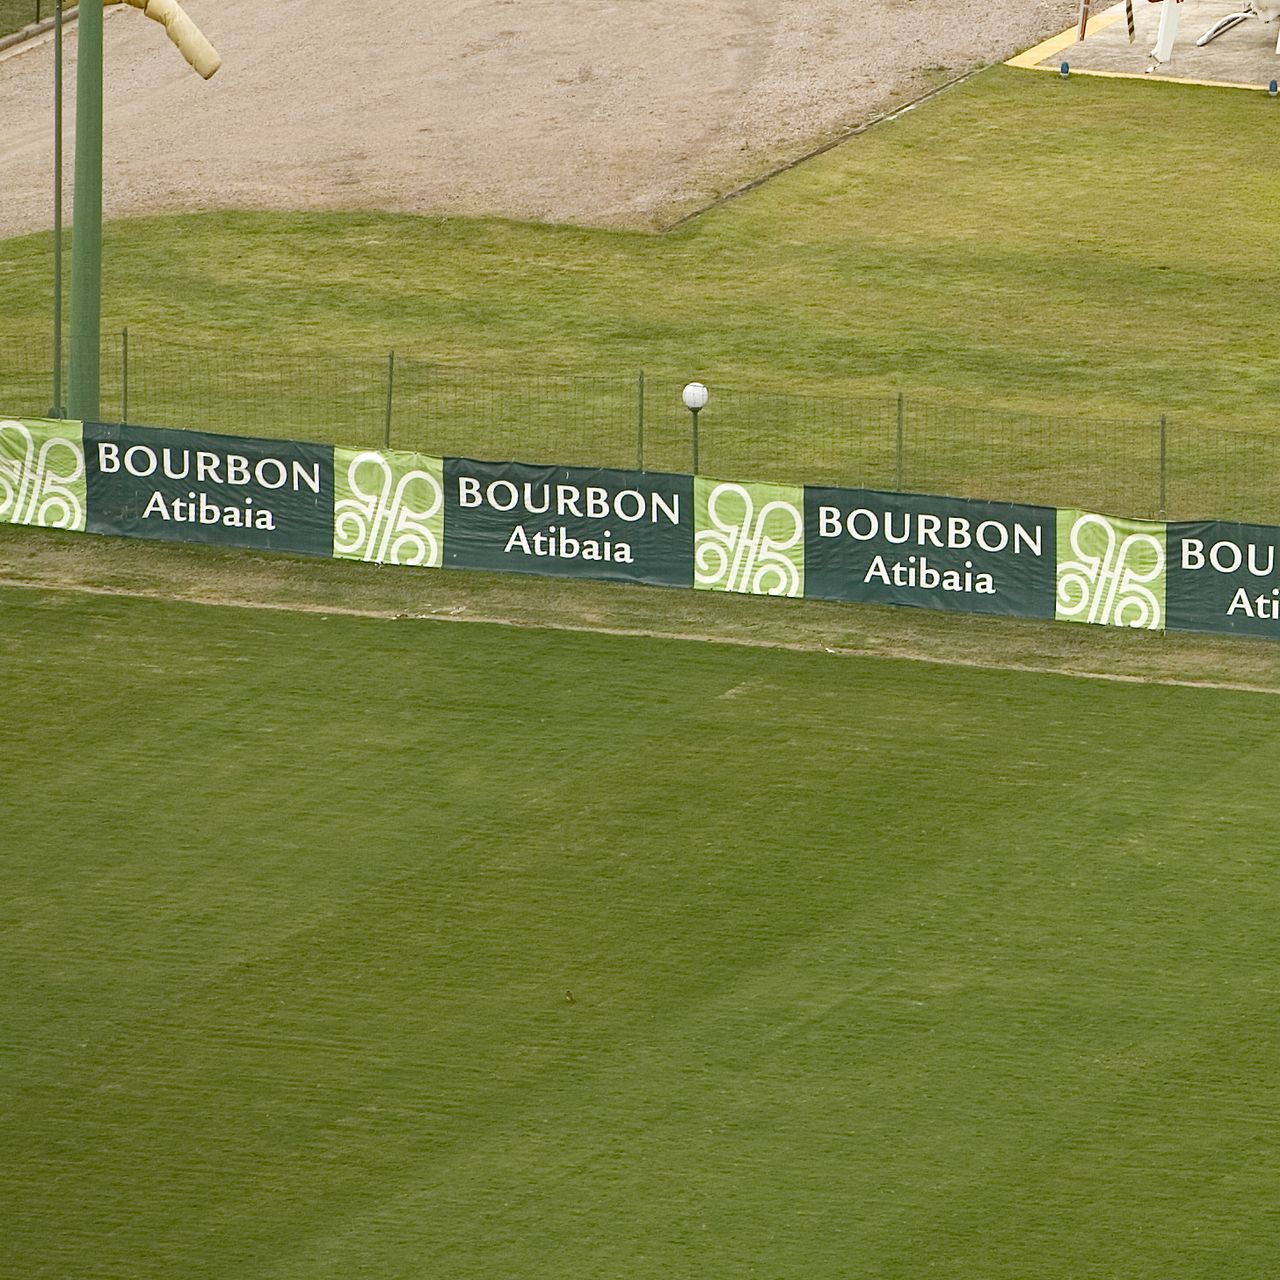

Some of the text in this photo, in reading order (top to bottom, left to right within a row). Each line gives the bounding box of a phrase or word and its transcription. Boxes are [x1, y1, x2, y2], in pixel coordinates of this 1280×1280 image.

[97, 442, 320, 494] BOURBON
[141, 491, 276, 531] Atibaia
[458, 476, 680, 525] BOURBON
[503, 525, 635, 564] Atibaia
[819, 506, 1042, 557] BOURBON
[863, 555, 997, 595] Atibaia
